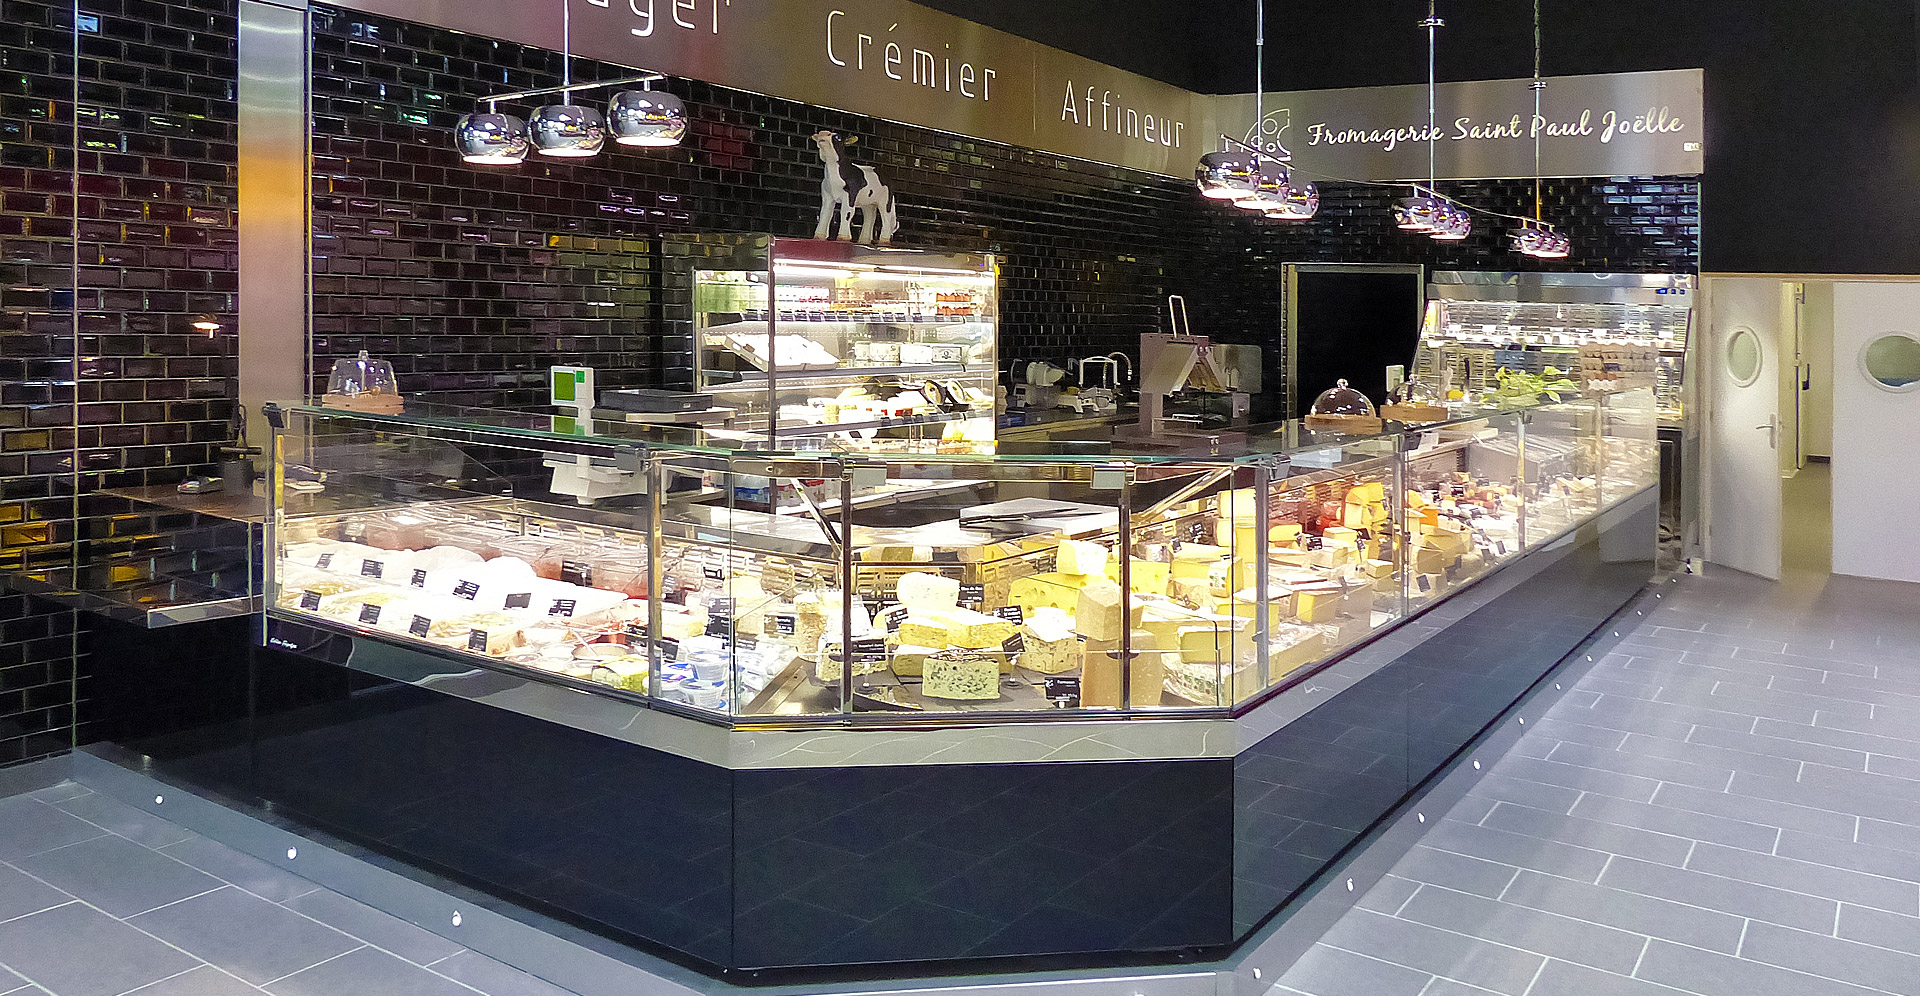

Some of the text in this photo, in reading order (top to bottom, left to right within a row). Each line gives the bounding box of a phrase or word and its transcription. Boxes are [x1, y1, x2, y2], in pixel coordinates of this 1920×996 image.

[826, 10, 997, 101] Crémier
[1061, 80, 1185, 149] Affineur
[1307, 106, 1686, 153] Fromagerie Saint Paul Joëlle
